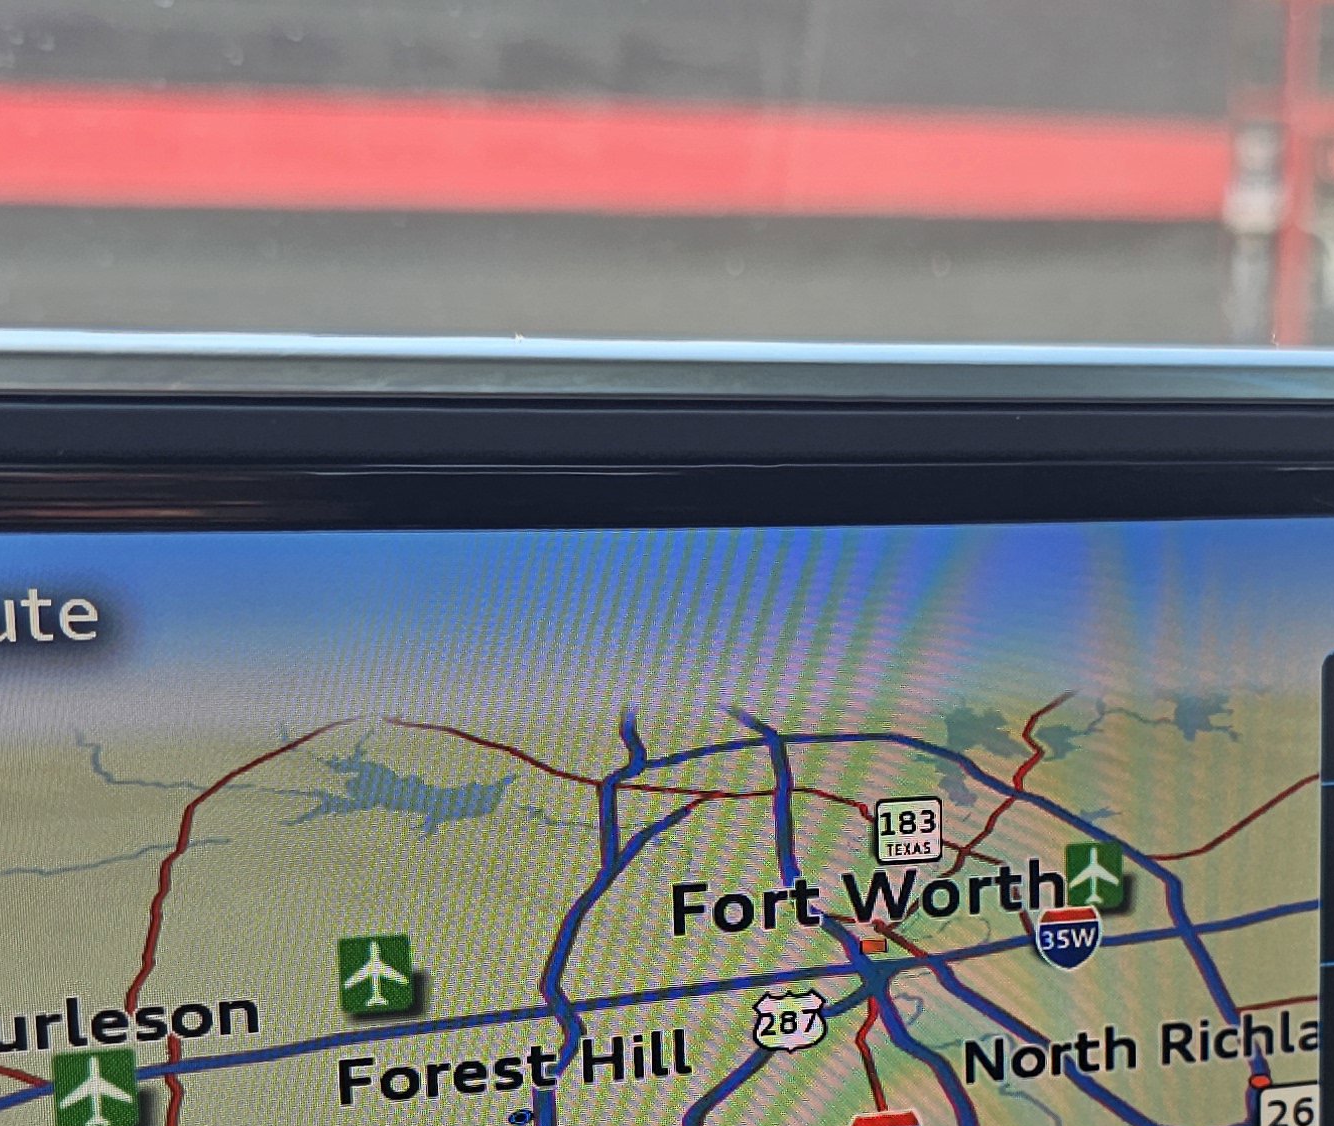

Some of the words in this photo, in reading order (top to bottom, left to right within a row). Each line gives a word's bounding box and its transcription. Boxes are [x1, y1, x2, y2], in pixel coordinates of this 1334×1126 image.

[880, 809, 936, 838] 183
[886, 841, 931, 858] TEXAS
[673, 880, 819, 936] Fort
[842, 859, 1064, 923] Worth
[1041, 926, 1095, 951] 35W
[760, 1007, 818, 1037] 287
[339, 1044, 555, 1105] Forest
[582, 1028, 690, 1083] Hill
[965, 1026, 1137, 1084] North
